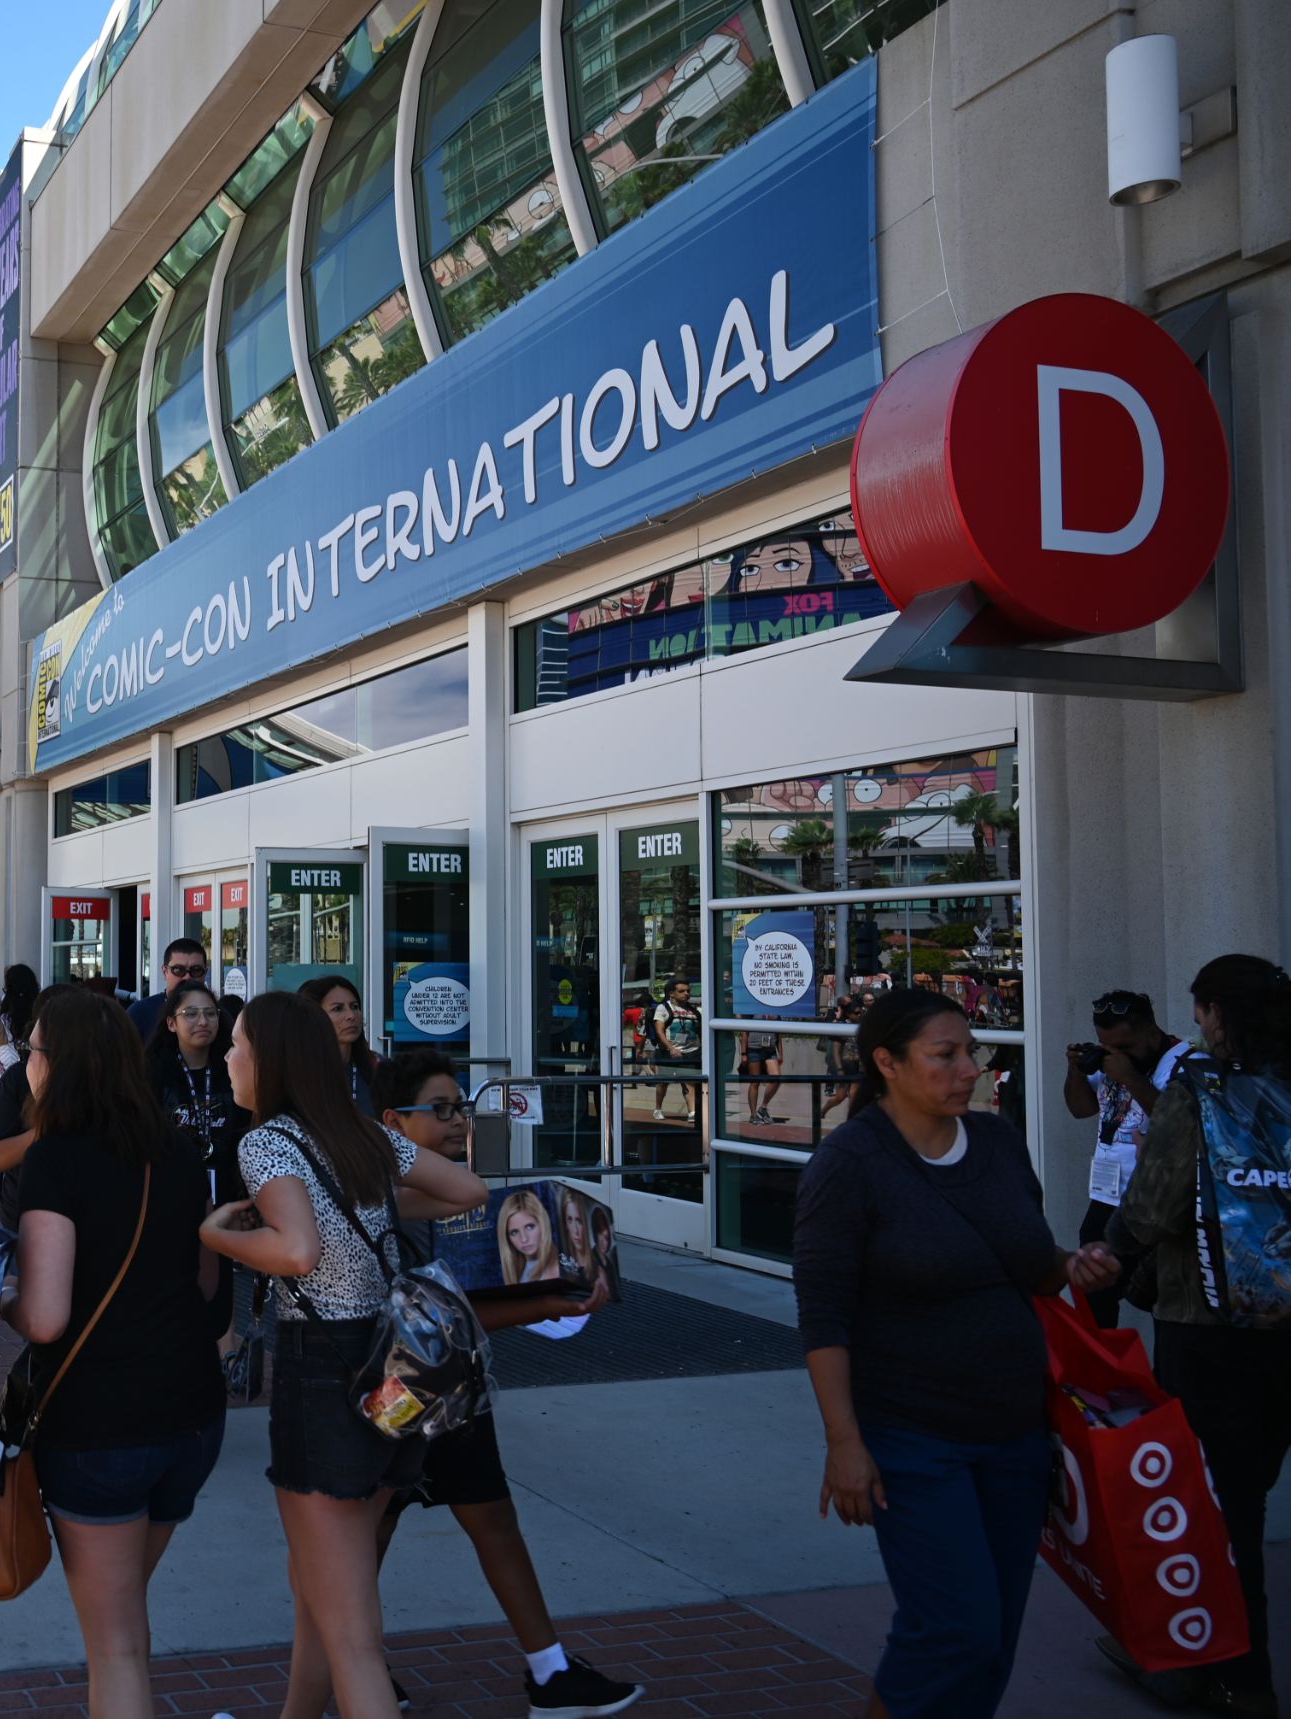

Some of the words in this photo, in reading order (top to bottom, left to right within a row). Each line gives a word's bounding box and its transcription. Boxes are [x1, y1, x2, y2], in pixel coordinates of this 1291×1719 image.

[1037, 364, 1165, 555] D
[86, 575, 252, 714] COMIC-CON
[266, 269, 836, 632] INTERNATIONAL
[0, 484, 12, 544] 50
[64, 607, 112, 723] Welcome
[113, 585, 125, 614] to
[46, 655, 61, 681] CON
[38, 662, 47, 729] COMIC
[638, 832, 682, 859] ENTER
[408, 852, 462, 873] ENTER
[546, 845, 584, 869] ENTER
[290, 869, 341, 887] ENTER
[193, 891, 205, 907] EXIT
[230, 886, 243, 903] EXIT
[69, 902, 93, 914] EXIT
[764, 943, 798, 951] CALIFORNIA
[764, 961, 791, 969] SMOKING
[759, 988, 795, 996] ENTRANCES
